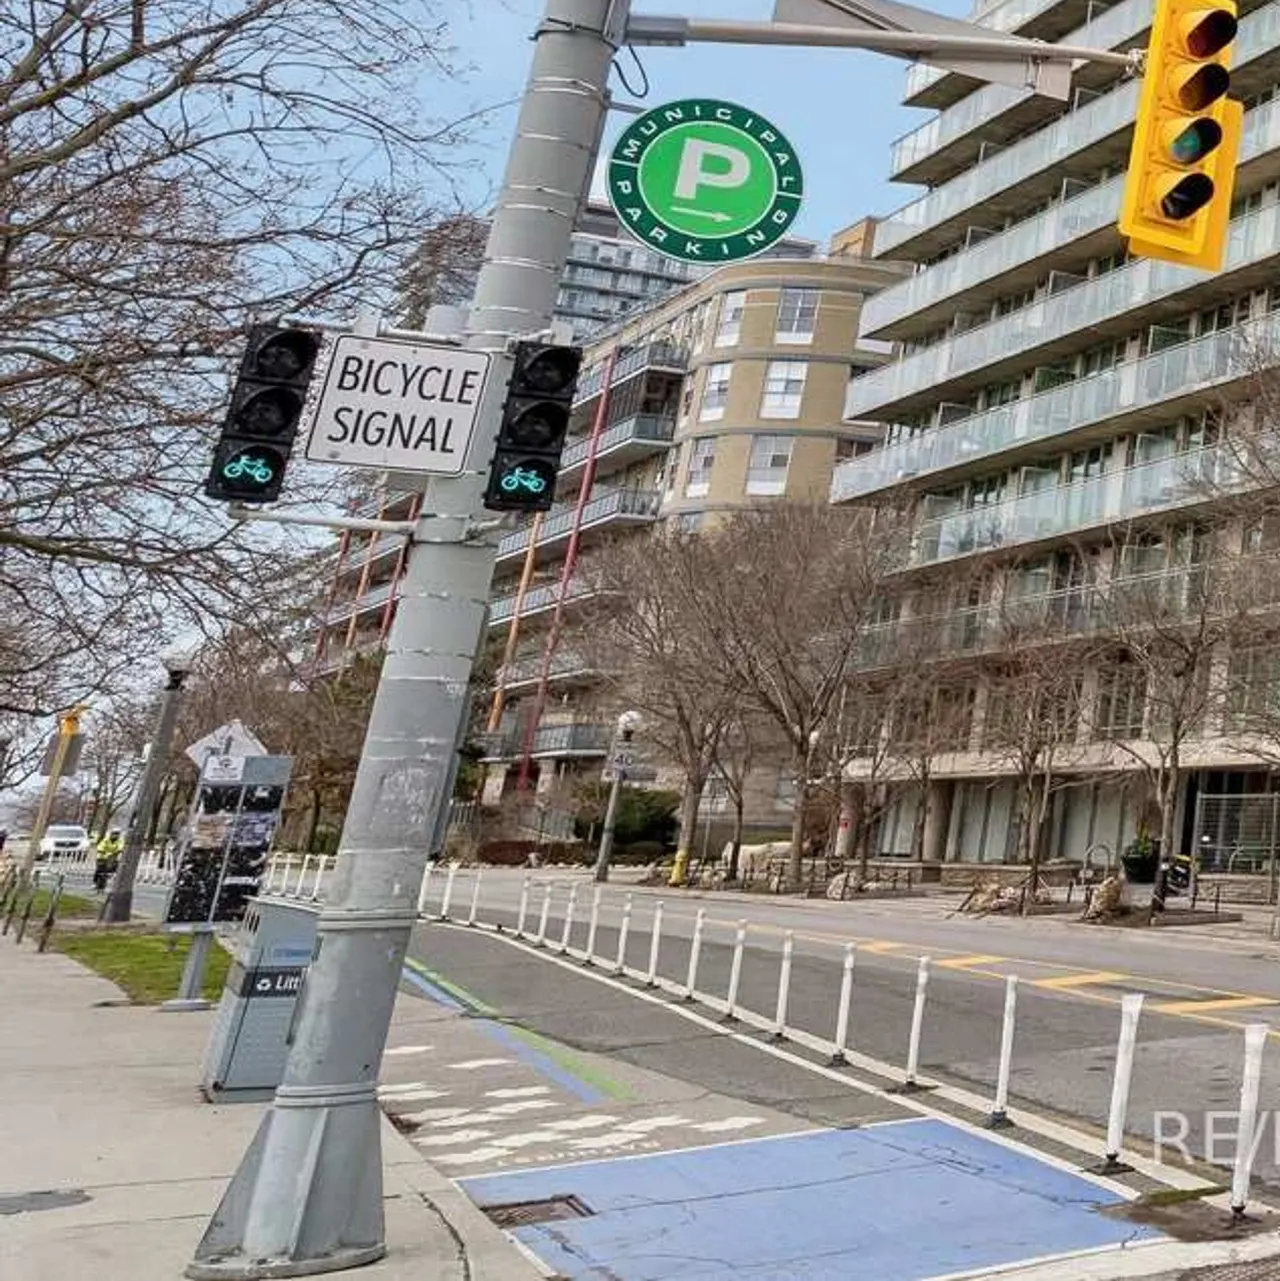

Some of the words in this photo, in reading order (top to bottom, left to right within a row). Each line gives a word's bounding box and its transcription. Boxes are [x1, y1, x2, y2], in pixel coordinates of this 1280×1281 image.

[622, 106, 795, 188] MUNICIPAL
[672, 136, 751, 200] P
[616, 179, 788, 255] PARKING
[337, 355, 480, 405] BICYCLE
[327, 407, 455, 453] SIGNAL
[275, 974, 300, 990] Litt
